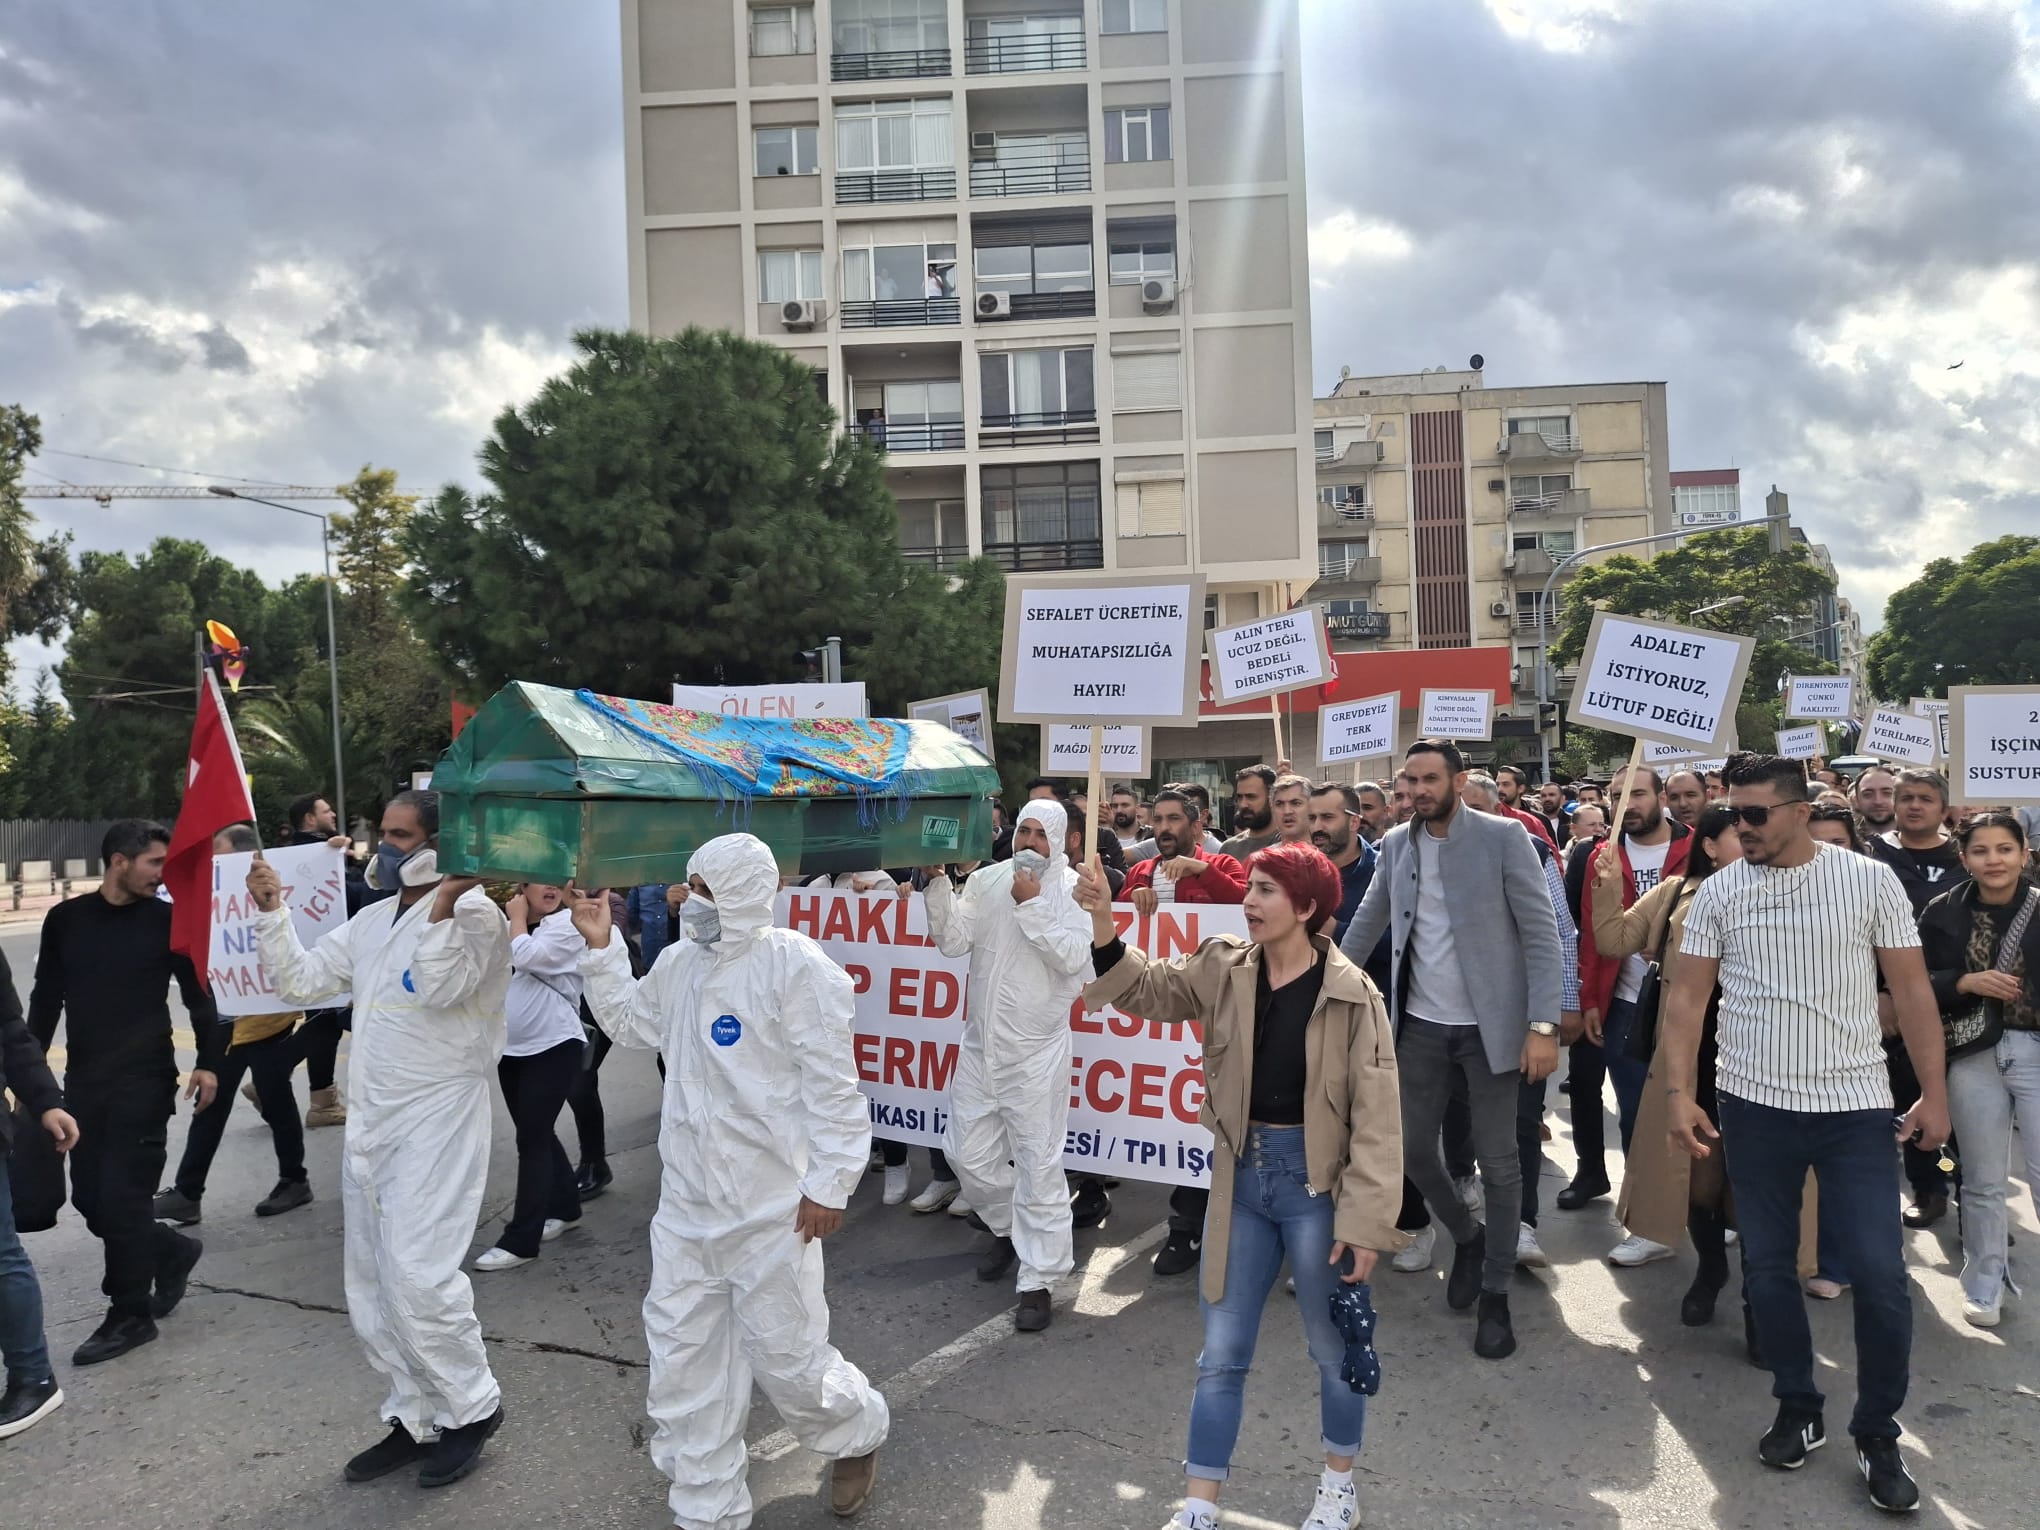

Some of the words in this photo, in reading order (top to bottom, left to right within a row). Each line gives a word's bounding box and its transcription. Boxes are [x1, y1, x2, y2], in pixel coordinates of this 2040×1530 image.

[1027, 608, 1094, 621] SEFALET
[1099, 602, 1183, 620] ÜCRETİNE,
[1234, 626, 1262, 641] ALIN
[1032, 641, 1173, 659] MUHATAPSIZLIĞA
[1228, 642, 1262, 659] UCUZ
[1630, 633, 1706, 660] ADALET
[1606, 659, 1709, 699] İSTİYORUZ,
[1073, 684, 1126, 697] HAYIR!
[1808, 693, 1835, 701] ÇÜNKÜ
[1331, 704, 1387, 722] GREVDEYİZ
[1587, 691, 1647, 716] LÜTUF
[1651, 705, 1714, 732] DEĞİL!
[1877, 713, 1901, 725] HAK
[1346, 724, 1372, 736] TERK
[1786, 732, 1814, 743] ADALET
[1329, 738, 1386, 756] EDİLMEDİK!
[1869, 741, 1911, 757] ALINIR!
[1632, 868, 1659, 881] THE
[1123, 1138, 1167, 1168] TPI
